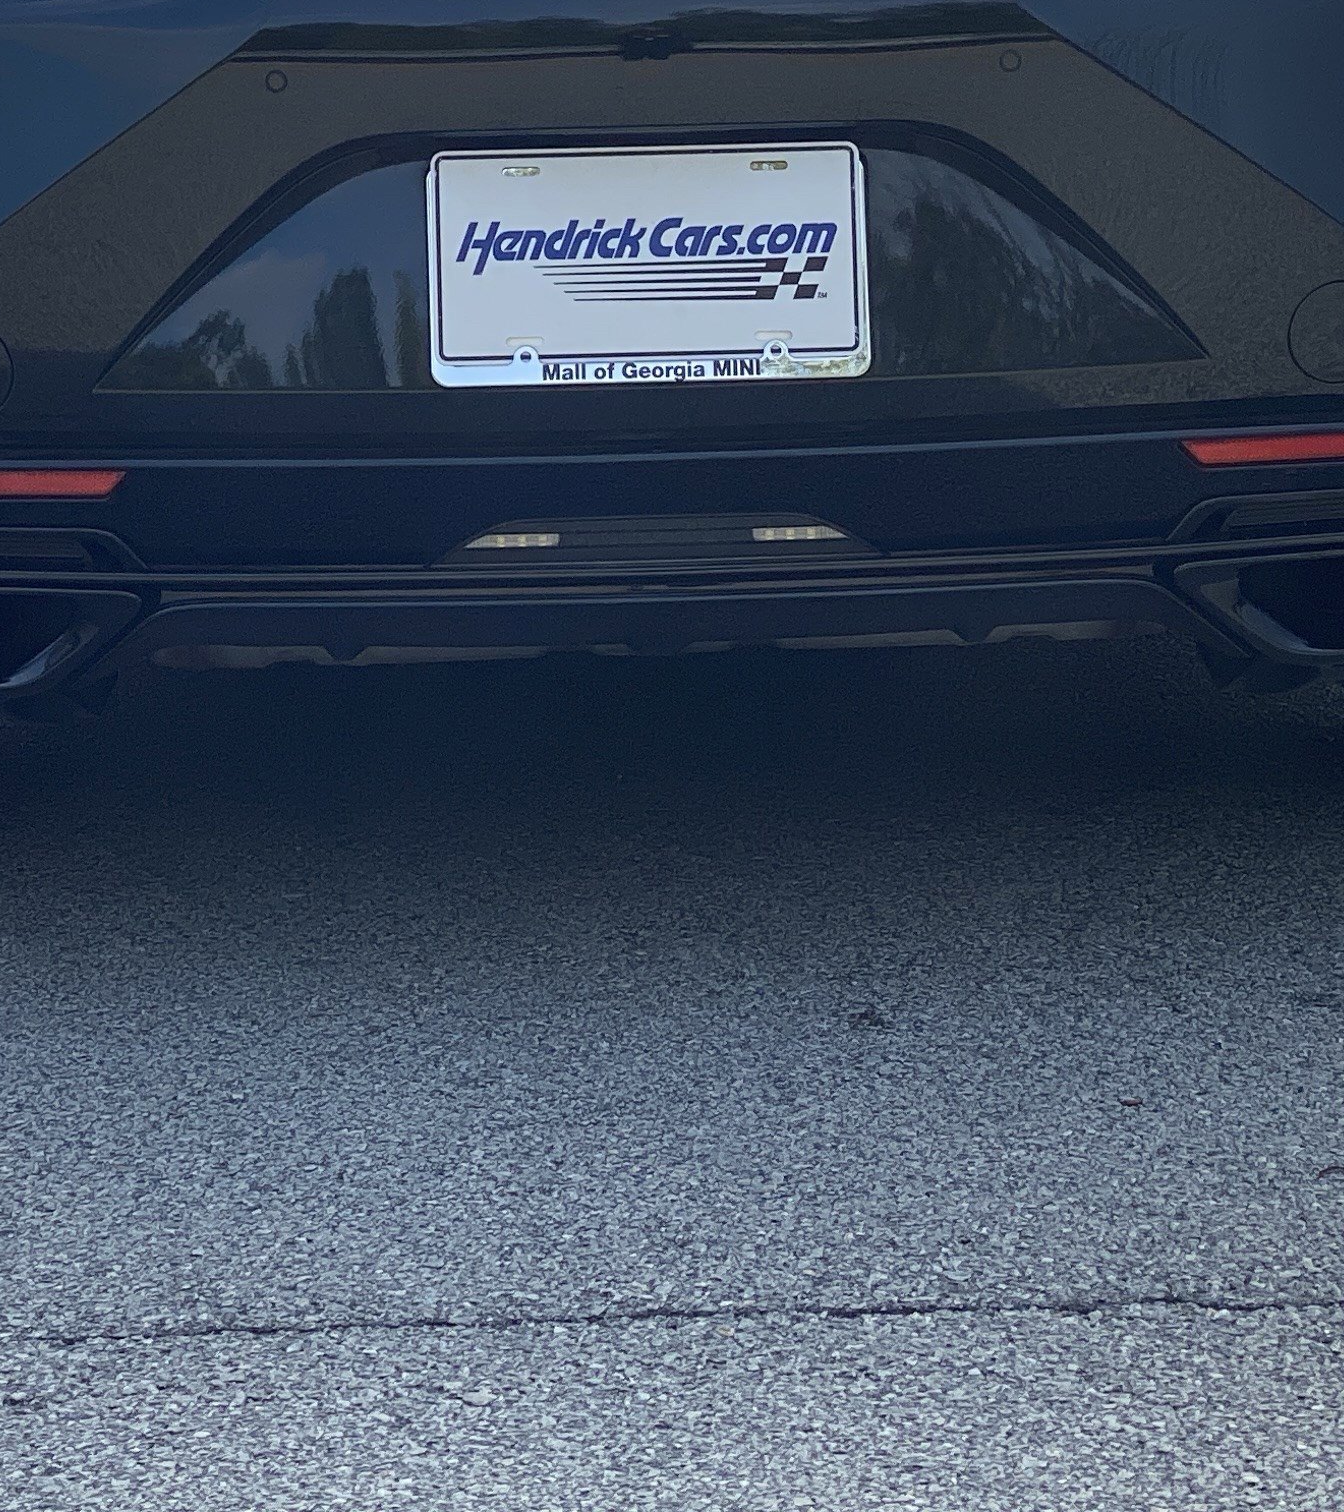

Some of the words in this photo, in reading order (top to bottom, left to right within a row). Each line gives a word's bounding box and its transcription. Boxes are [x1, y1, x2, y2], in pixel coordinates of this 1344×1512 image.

[542, 362, 586, 381] Mall
[594, 362, 615, 380] of
[621, 360, 706, 383] Georgia
[712, 358, 761, 376] MINI
